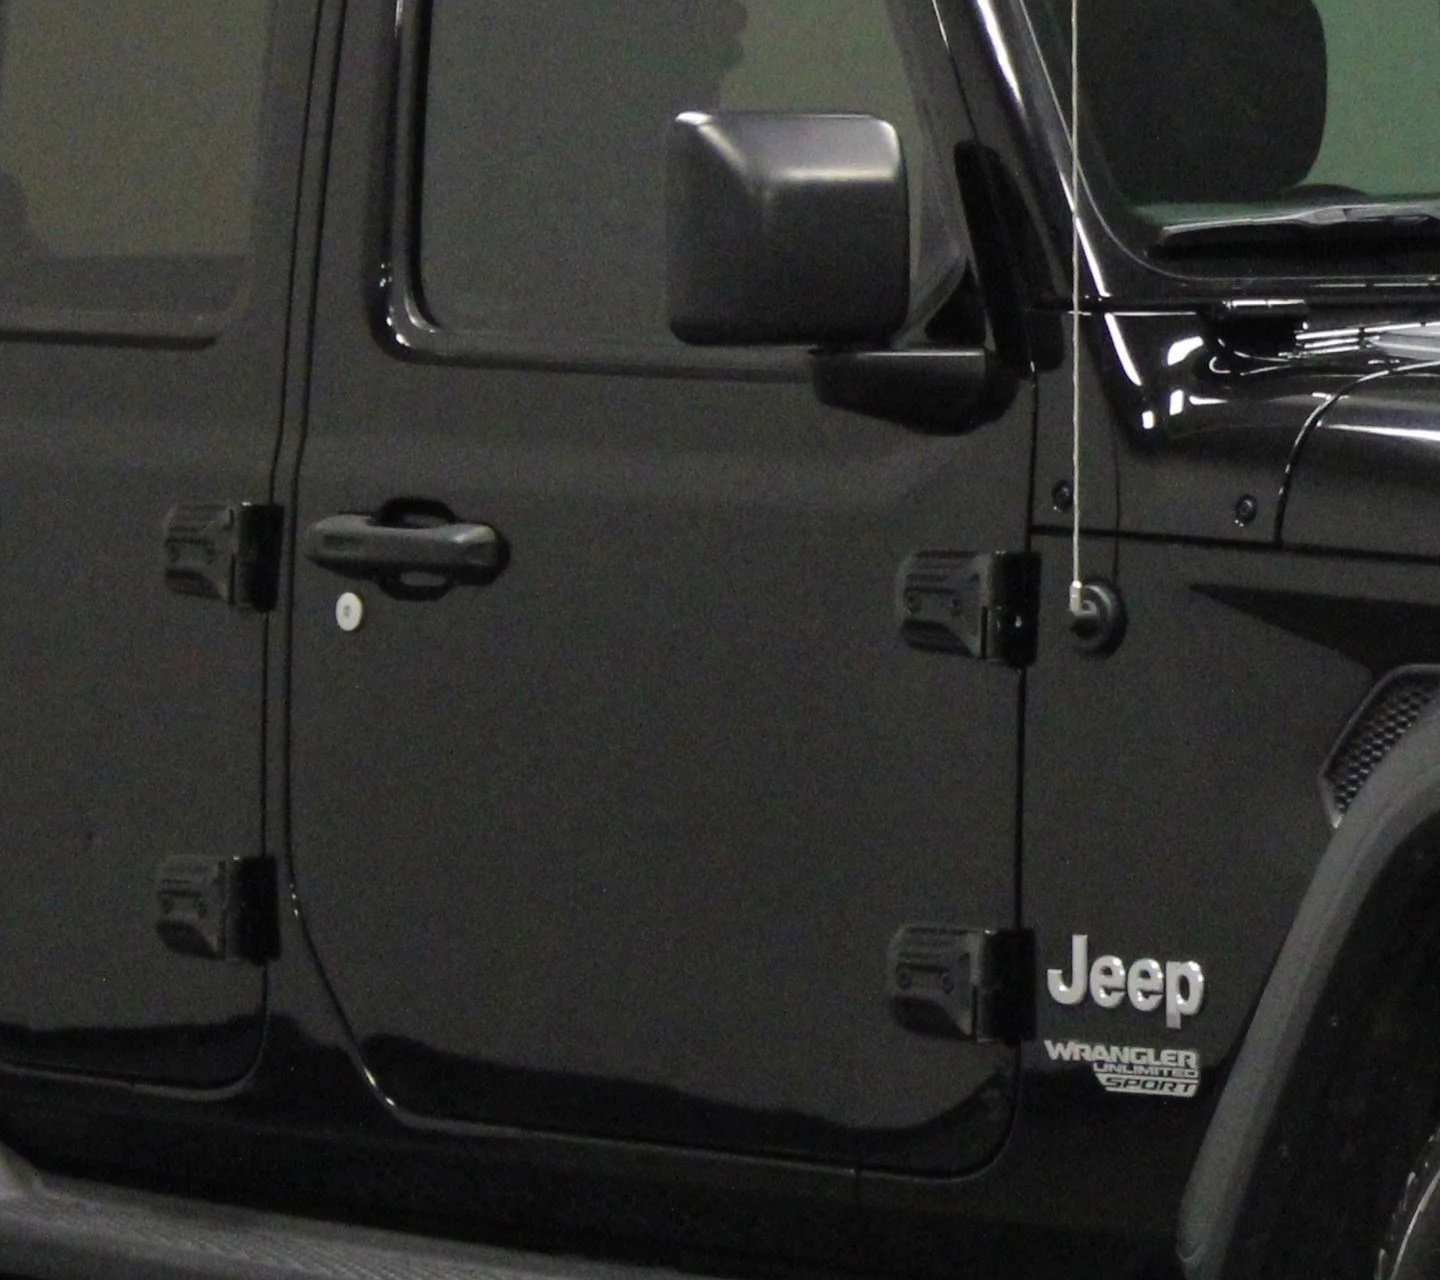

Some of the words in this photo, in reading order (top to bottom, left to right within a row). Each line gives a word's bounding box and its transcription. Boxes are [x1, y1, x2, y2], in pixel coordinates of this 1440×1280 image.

[1047, 934, 1205, 1029] Jeep
[1044, 1039, 1198, 1068] WRANGLER
[1092, 1062, 1199, 1079] UNLIMITED
[1106, 1078, 1197, 1093] SPORT
